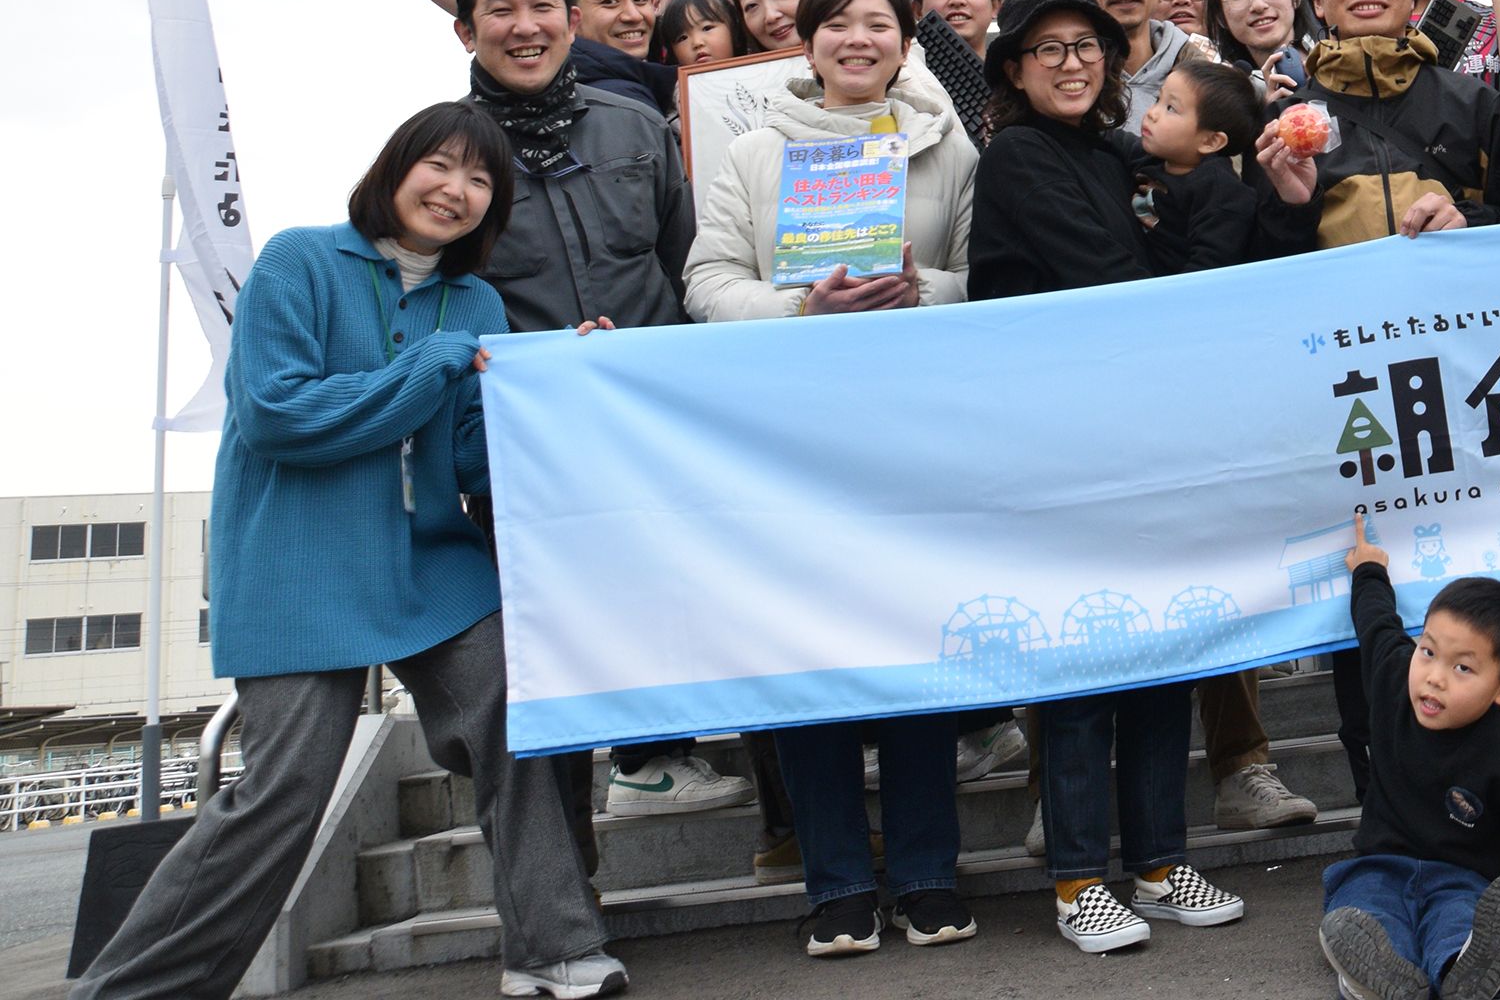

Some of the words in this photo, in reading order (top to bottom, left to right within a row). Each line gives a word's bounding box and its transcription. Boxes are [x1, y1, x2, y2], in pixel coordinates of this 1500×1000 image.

[793, 170, 894, 194] 住みたい田舎
[783, 185, 901, 207] ベストランキング
[1354, 486, 1482, 515] asakura
